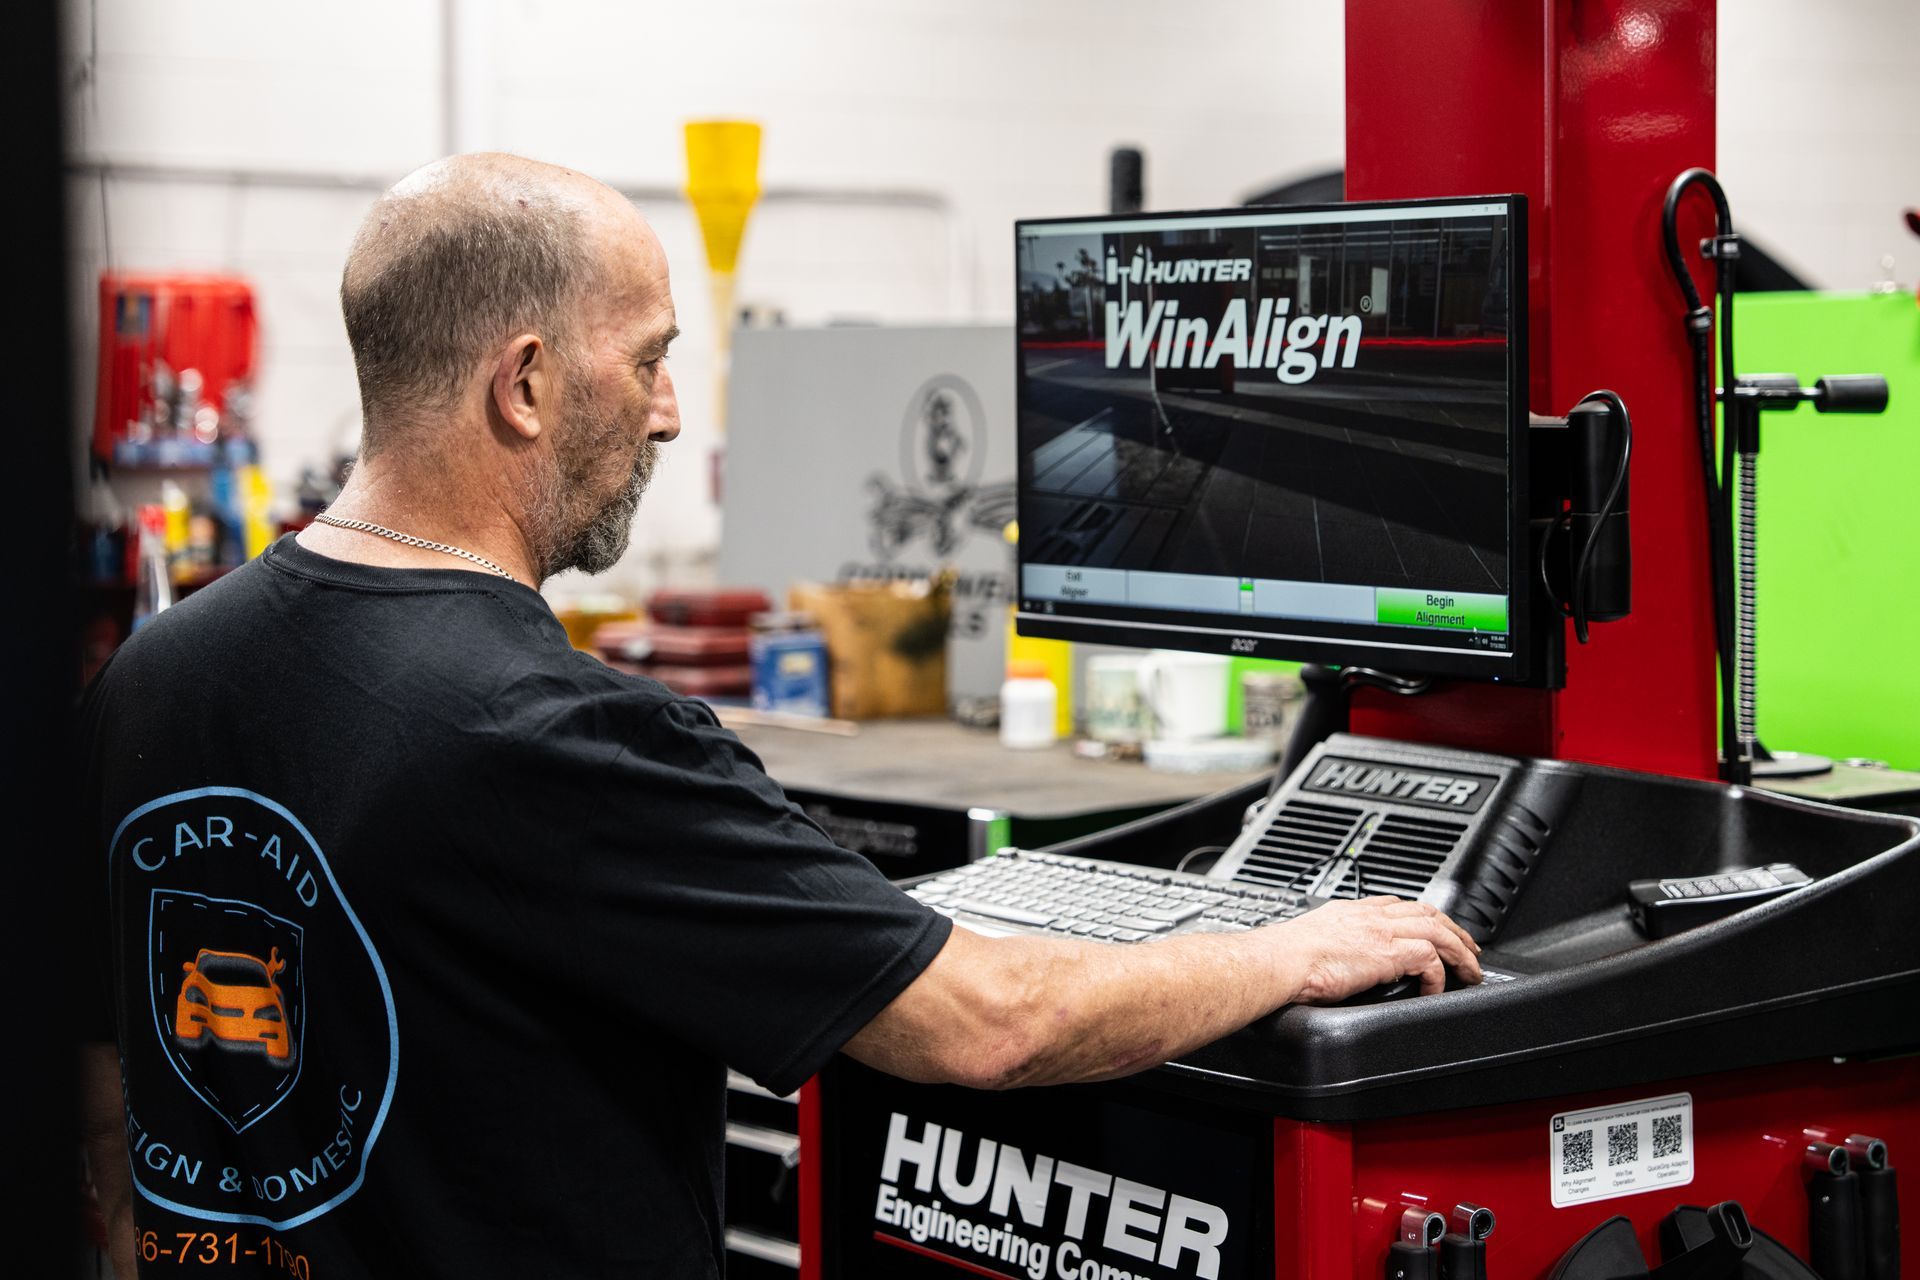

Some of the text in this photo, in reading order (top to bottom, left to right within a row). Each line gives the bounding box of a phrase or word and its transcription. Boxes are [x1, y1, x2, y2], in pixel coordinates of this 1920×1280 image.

[1144, 258, 1252, 283] HUNTER
[1426, 594, 1455, 609] Begin
[1416, 611, 1466, 626] Alignment
[1230, 638, 1259, 653] acer
[1314, 762, 1480, 806] HUNTER
[131, 815, 319, 908] CAR-AID
[219, 1166, 242, 1193] &
[881, 1112, 1229, 1280] HUNTER
[875, 1183, 1051, 1280] Engineering
